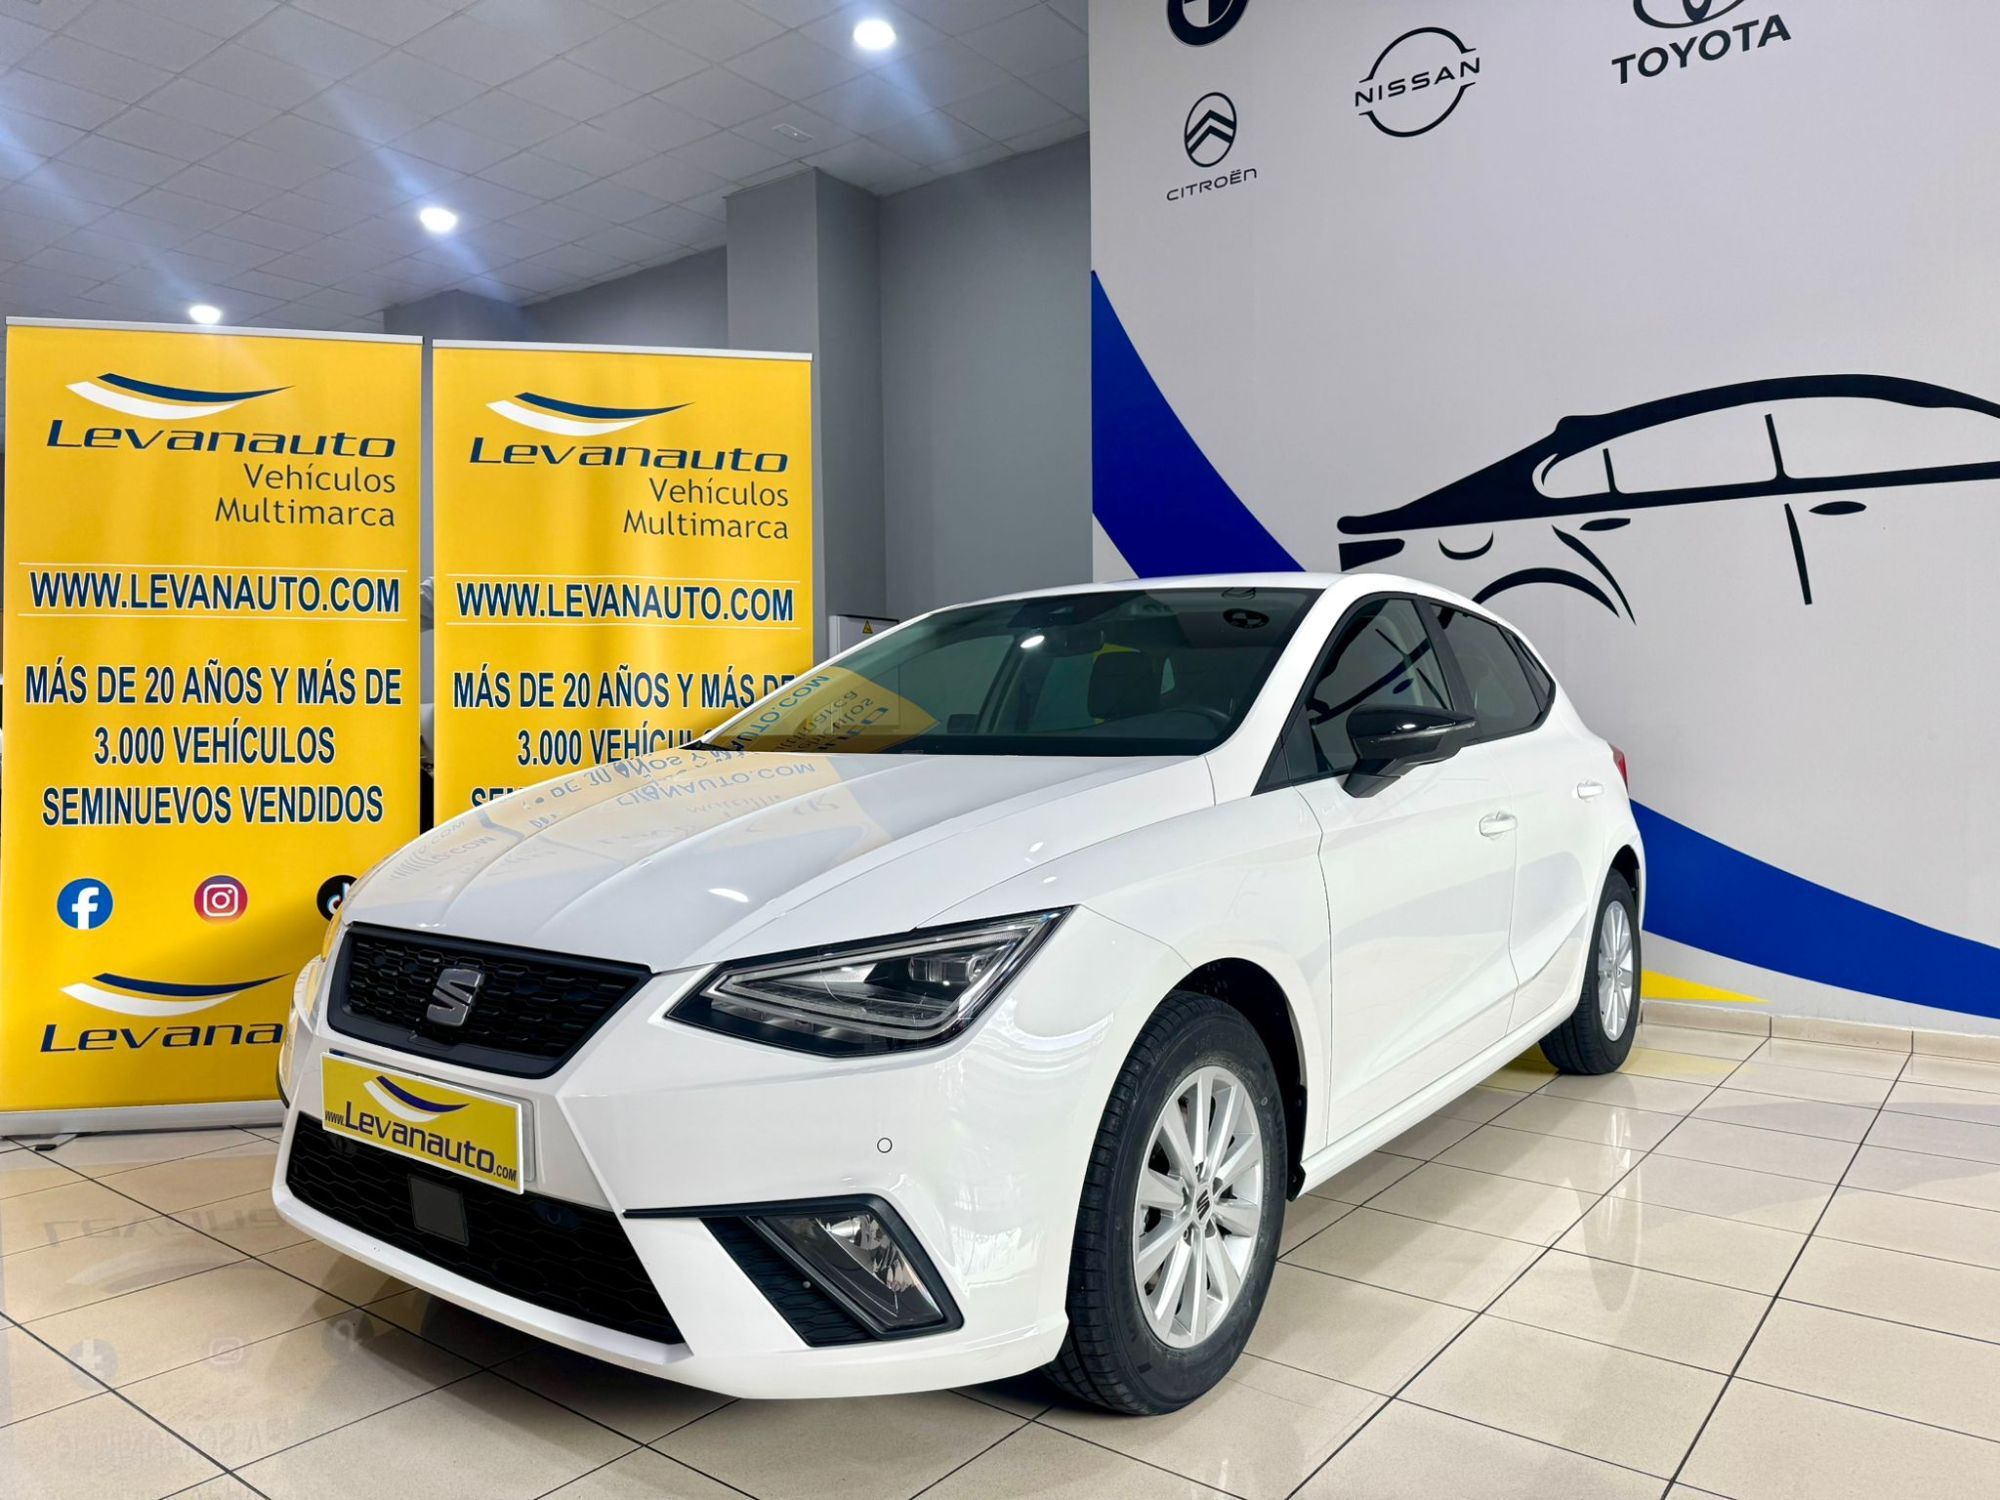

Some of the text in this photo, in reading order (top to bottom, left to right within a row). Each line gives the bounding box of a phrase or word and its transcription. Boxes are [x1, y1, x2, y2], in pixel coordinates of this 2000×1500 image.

[1611, 14, 1791, 84] TOYOTA
[1355, 57, 1480, 107] NISSAN
[46, 419, 396, 458] Levanauto
[469, 437, 788, 473] Levanauto
[243, 462, 396, 494] Vehículos
[649, 476, 788, 507] Vehículos
[215, 497, 395, 527] Multimarca
[623, 509, 789, 540] Multimarca
[29, 571, 400, 613] WWW.LEVANAUTO.COM
[456, 582, 794, 621] WWW.LEVANAUTO.COM
[25, 656, 402, 705] MÁS DE 20 AÑOS Y MÁS DE
[453, 664, 512, 708] MÁS
[520, 672, 557, 708] DE
[564, 672, 591, 708] 20
[598, 664, 669, 708] AÑOS
[677, 673, 694, 708] Y
[701, 665, 755, 708] MÁS
[94, 718, 335, 765] 3.000 VEHÍCULOS
[518, 729, 582, 766] 3.000
[43, 785, 384, 825] SEMINUEVOS VENDIDOS
[40, 1023, 282, 1053] Levana
